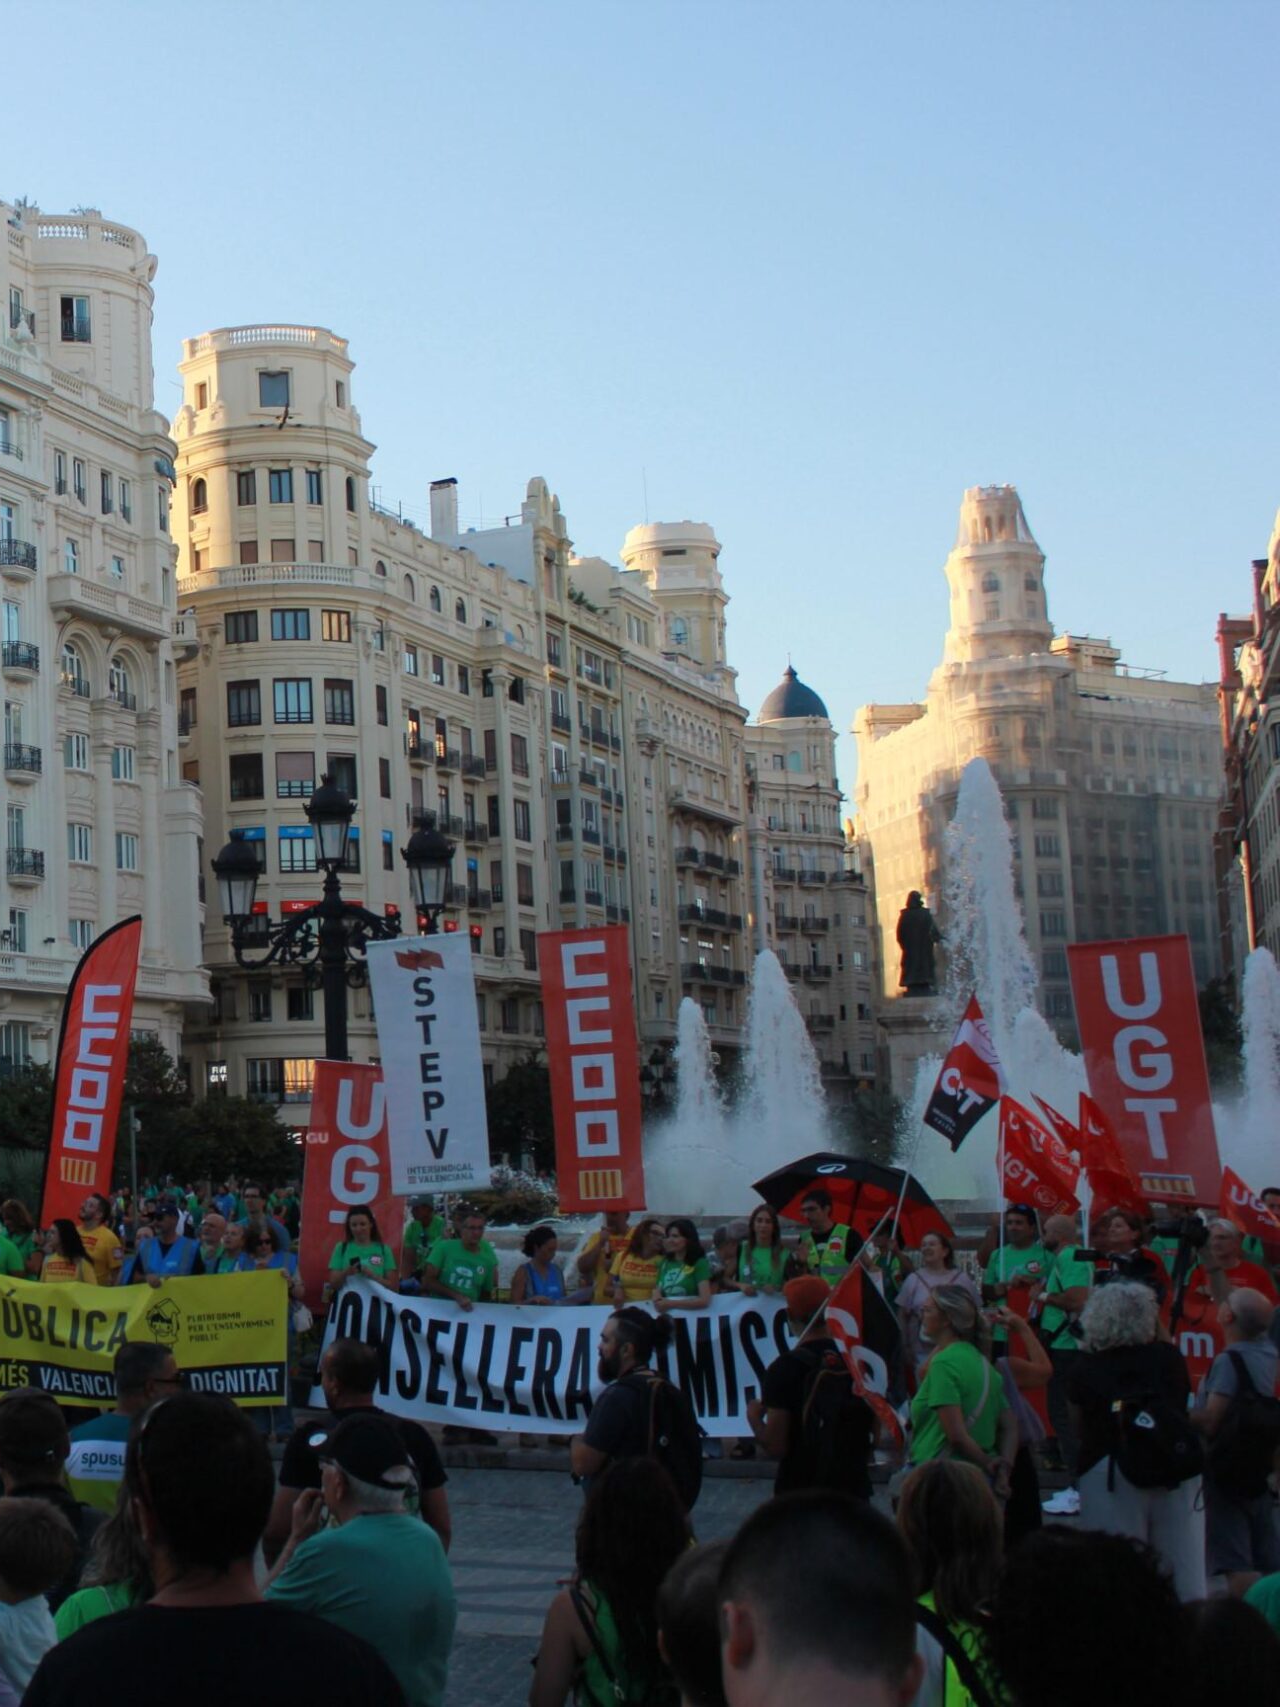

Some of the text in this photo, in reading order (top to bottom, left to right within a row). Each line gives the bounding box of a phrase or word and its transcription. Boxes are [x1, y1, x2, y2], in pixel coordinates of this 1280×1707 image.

[559, 940, 622, 1159] CCOO
[1099, 951, 1179, 1160] UGT
[62, 983, 123, 1153] CCOO
[406, 1163, 474, 1177] INTERSINDICAL
[417, 1173, 474, 1185] VALENCIANA
[187, 1312, 241, 1322] PLATAFORMA
[190, 1367, 279, 1393] DIGNITAT
